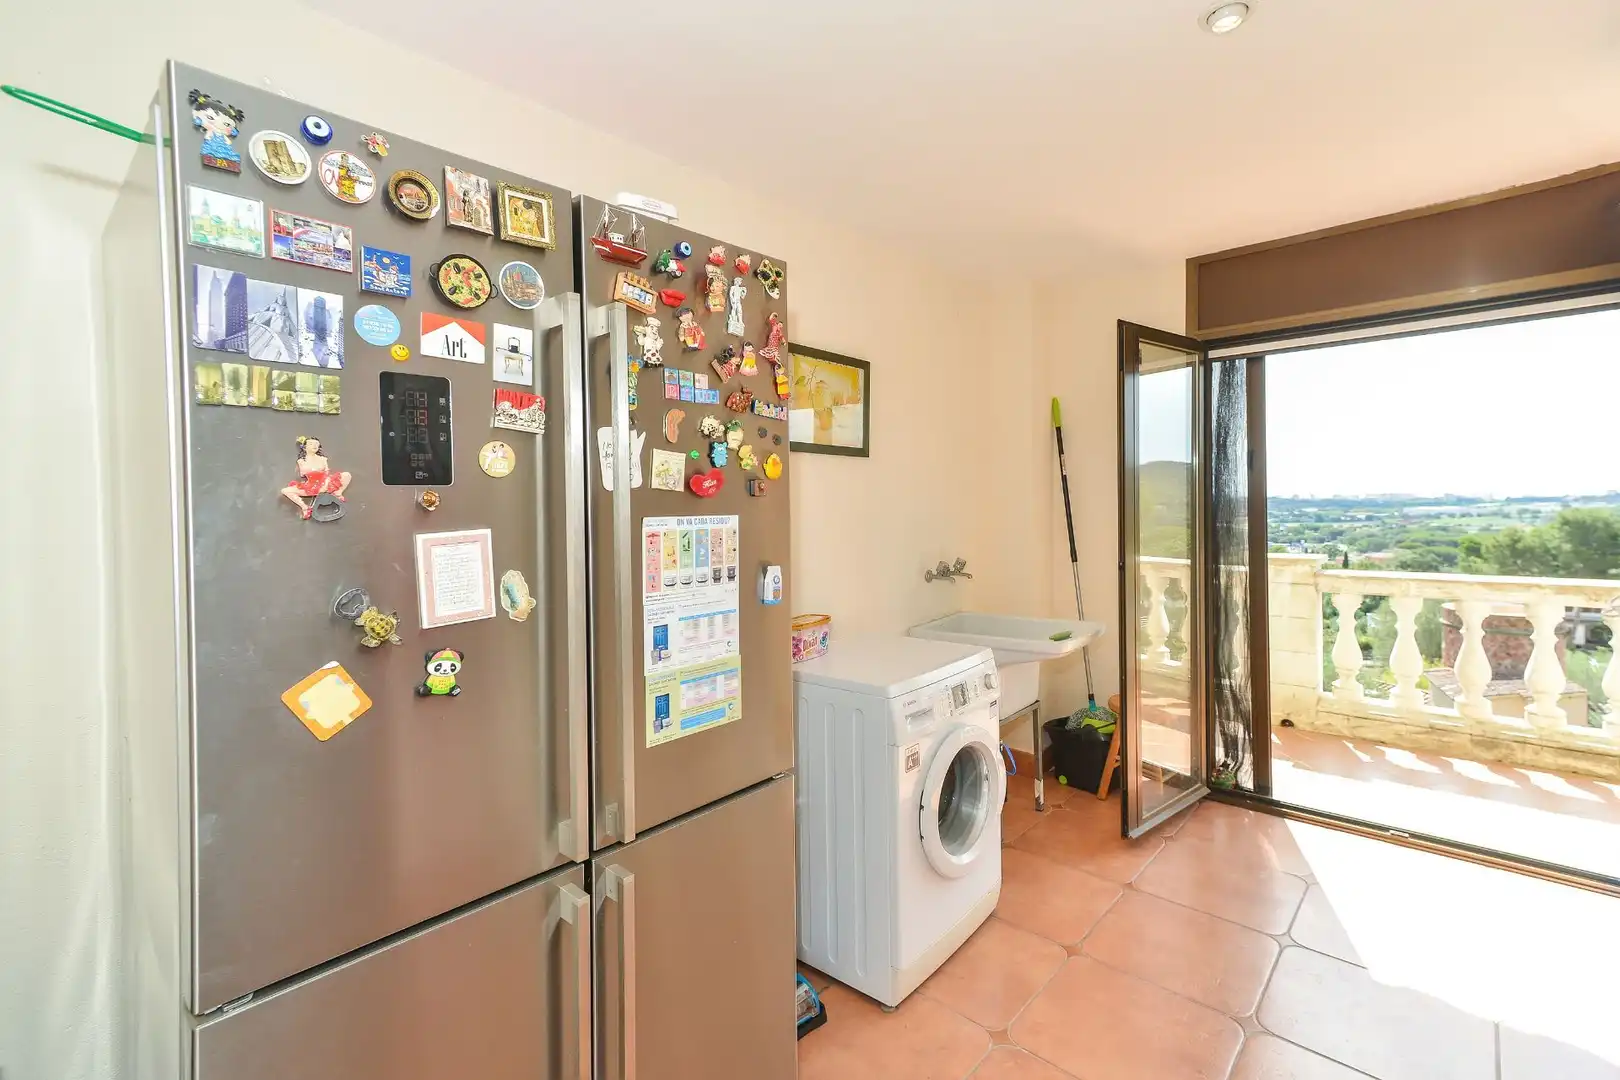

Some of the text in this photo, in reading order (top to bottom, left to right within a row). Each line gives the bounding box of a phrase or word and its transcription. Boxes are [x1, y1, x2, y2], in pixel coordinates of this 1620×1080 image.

[440, 333, 467, 359] Art
[676, 518, 685, 526] ON
[694, 517, 708, 526] CADA
